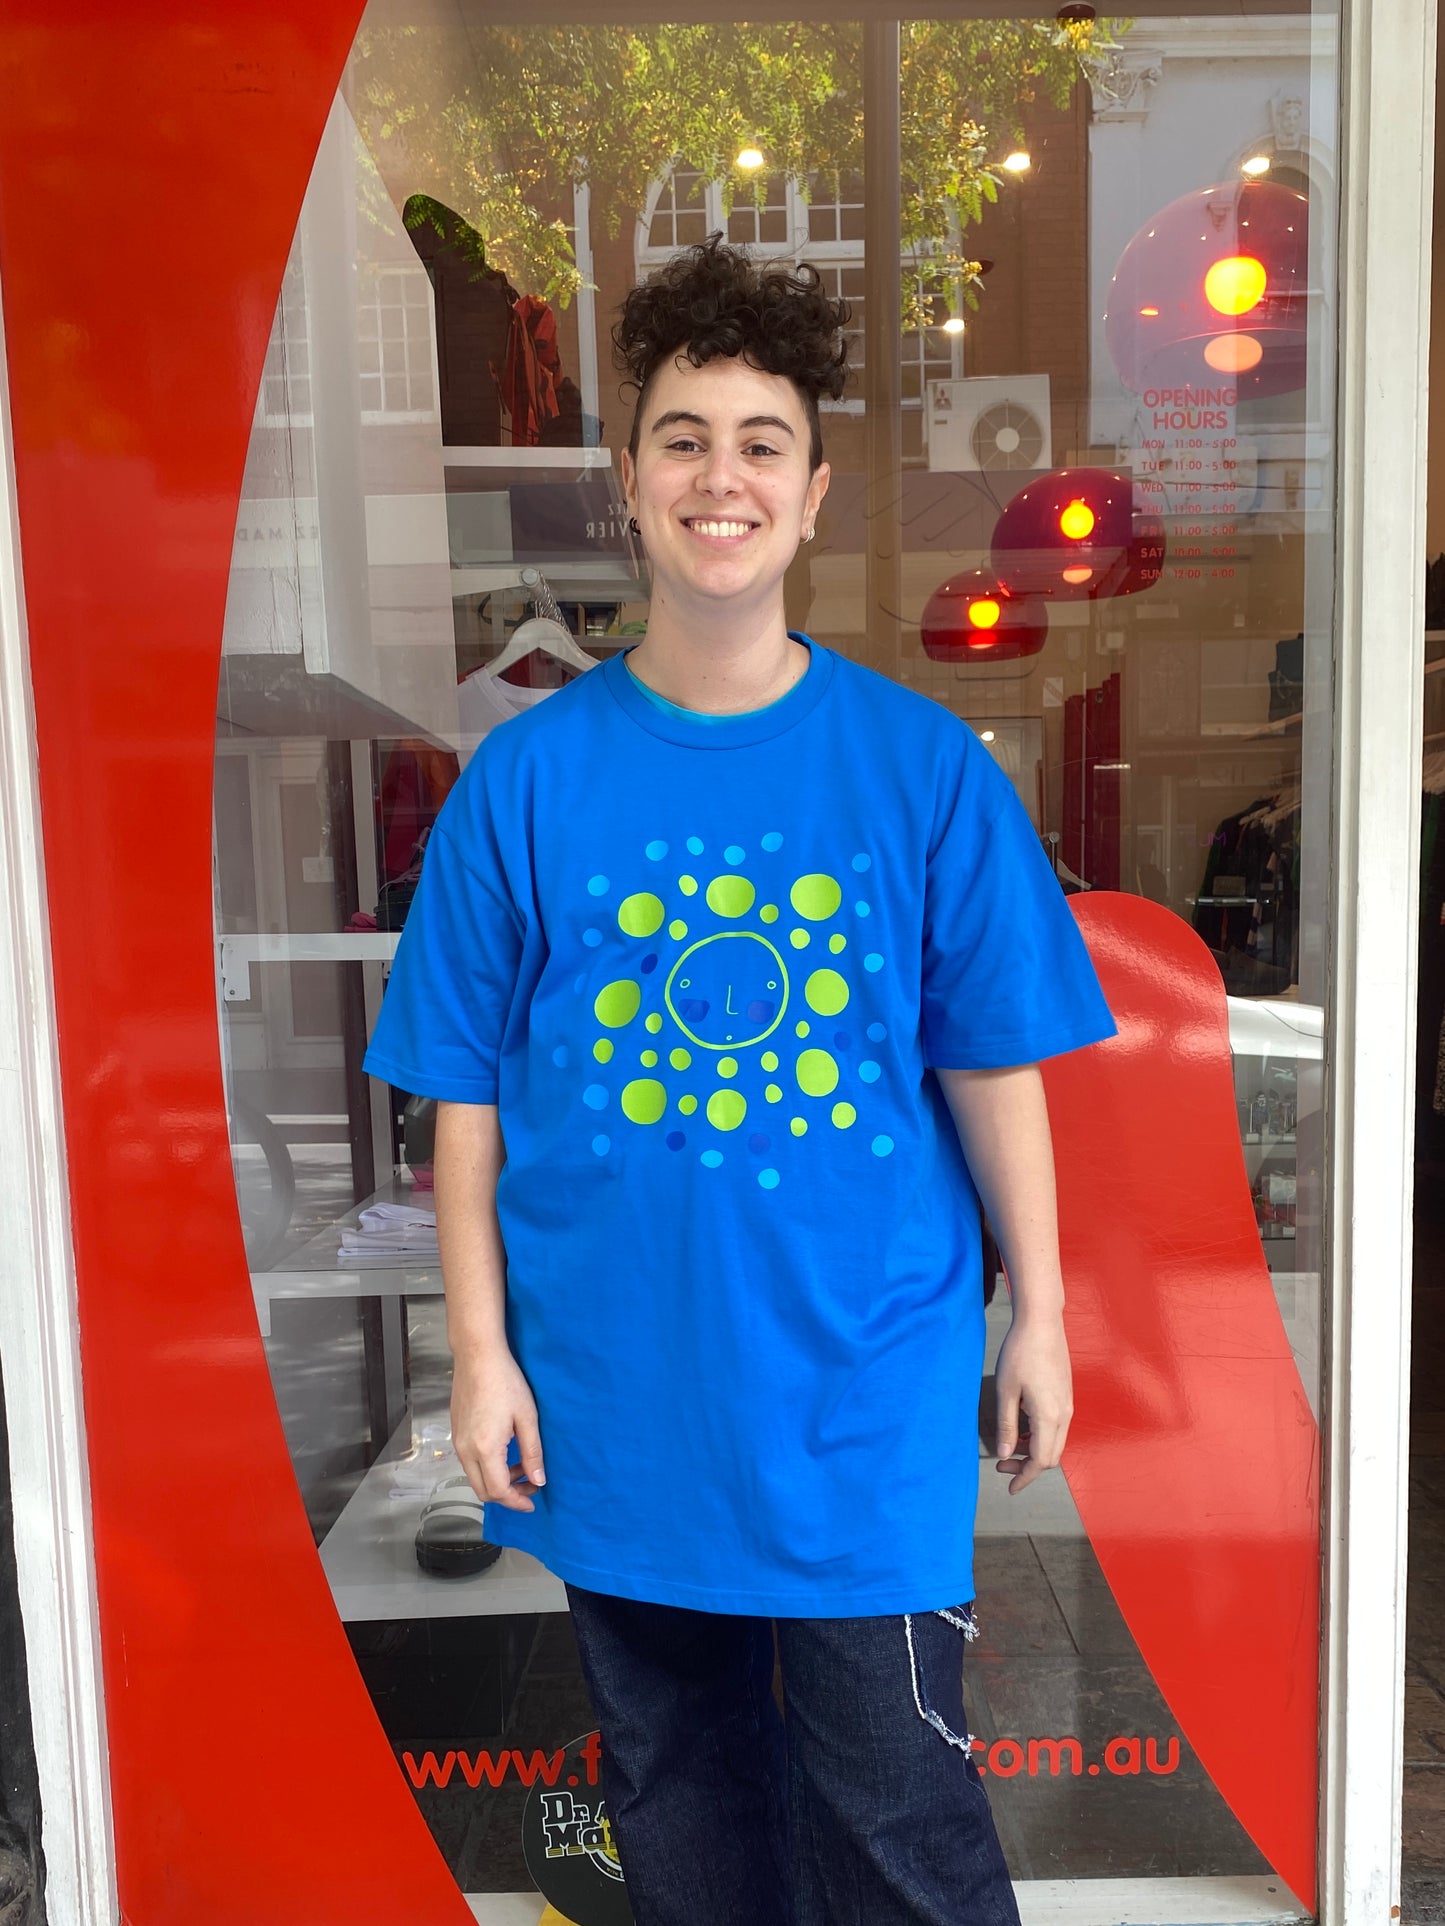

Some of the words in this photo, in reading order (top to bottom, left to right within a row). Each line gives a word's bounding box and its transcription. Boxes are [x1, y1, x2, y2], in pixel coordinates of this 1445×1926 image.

[1142, 388, 1238, 408] OPENING
[1152, 410, 1229, 431] HOURS
[1141, 439, 1166, 449] MON
[1174, 438, 1203, 449] 11:00
[1212, 438, 1237, 449] 5:00
[1141, 461, 1166, 471] TUE
[1174, 460, 1203, 471] 11:00
[1212, 460, 1237, 471] 5:00
[1141, 482, 1164, 493] WED
[1174, 482, 1203, 493] 11:00
[1212, 482, 1237, 493] 5:00
[1174, 526, 1203, 536] 11:00
[1212, 525, 1237, 536] 5:00
[1141, 547, 1164, 558] SAT
[1141, 569, 1164, 579] SUN
[1174, 568, 1203, 579] 12:00
